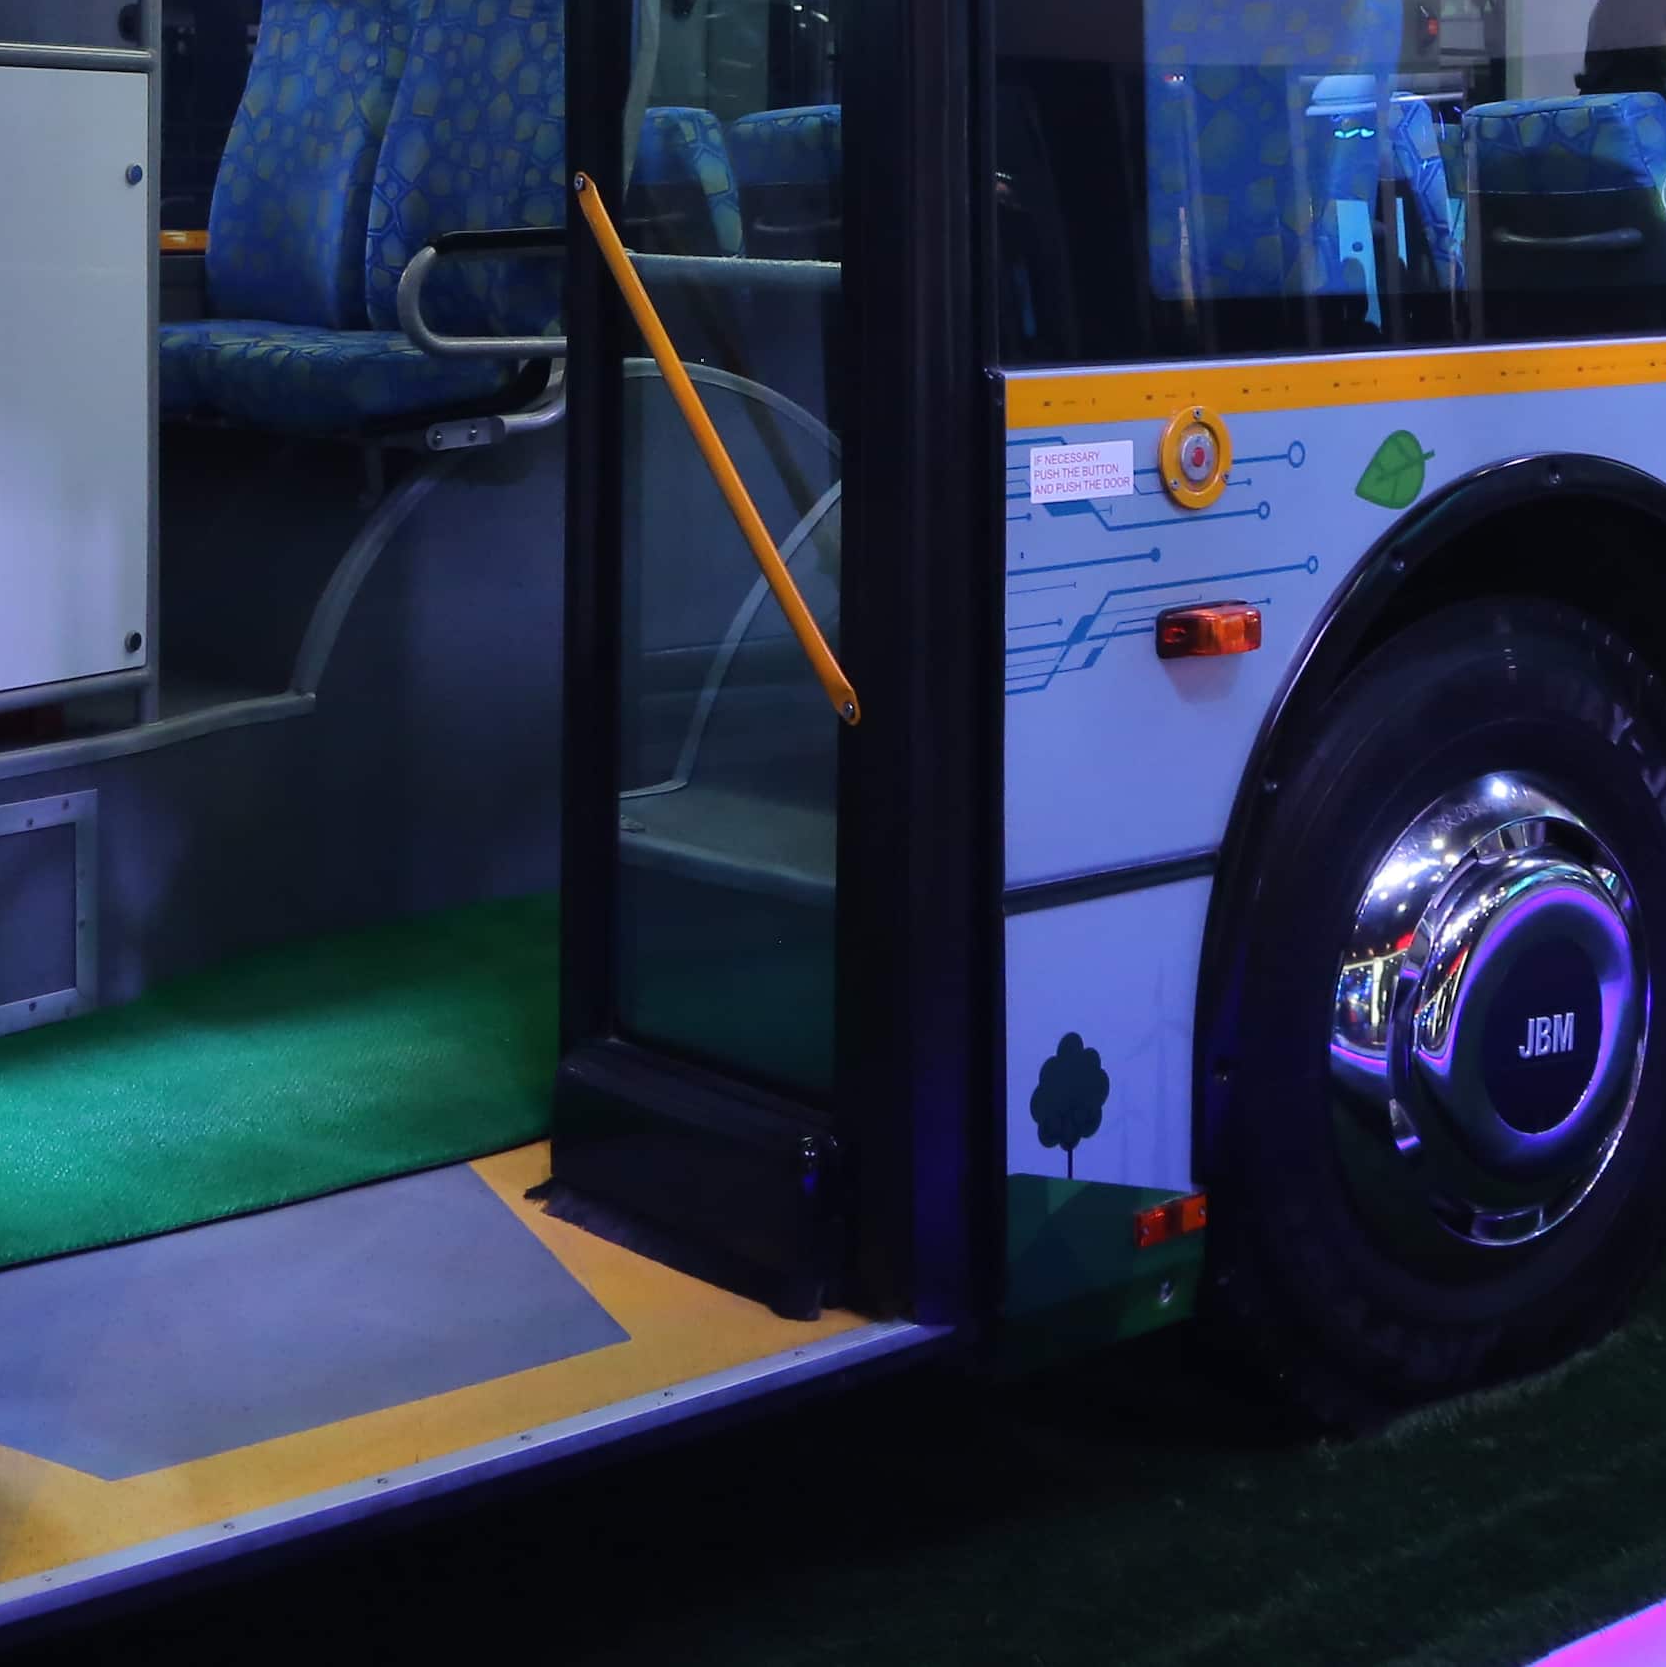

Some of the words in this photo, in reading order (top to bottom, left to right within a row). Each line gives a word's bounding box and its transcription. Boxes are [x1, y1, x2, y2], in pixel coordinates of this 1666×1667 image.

[1034, 455, 1044, 466] IF
[1044, 451, 1100, 465] NECESSARY
[1034, 468, 1060, 480] PUSH
[1062, 467, 1081, 478] THE
[1082, 463, 1119, 476] BUTTON
[1035, 484, 1054, 495] AND
[1056, 482, 1082, 493] PUSH
[1084, 479, 1102, 490] THE
[1103, 476, 1131, 489] DOOR
[1518, 1012, 1575, 1059] JBM
